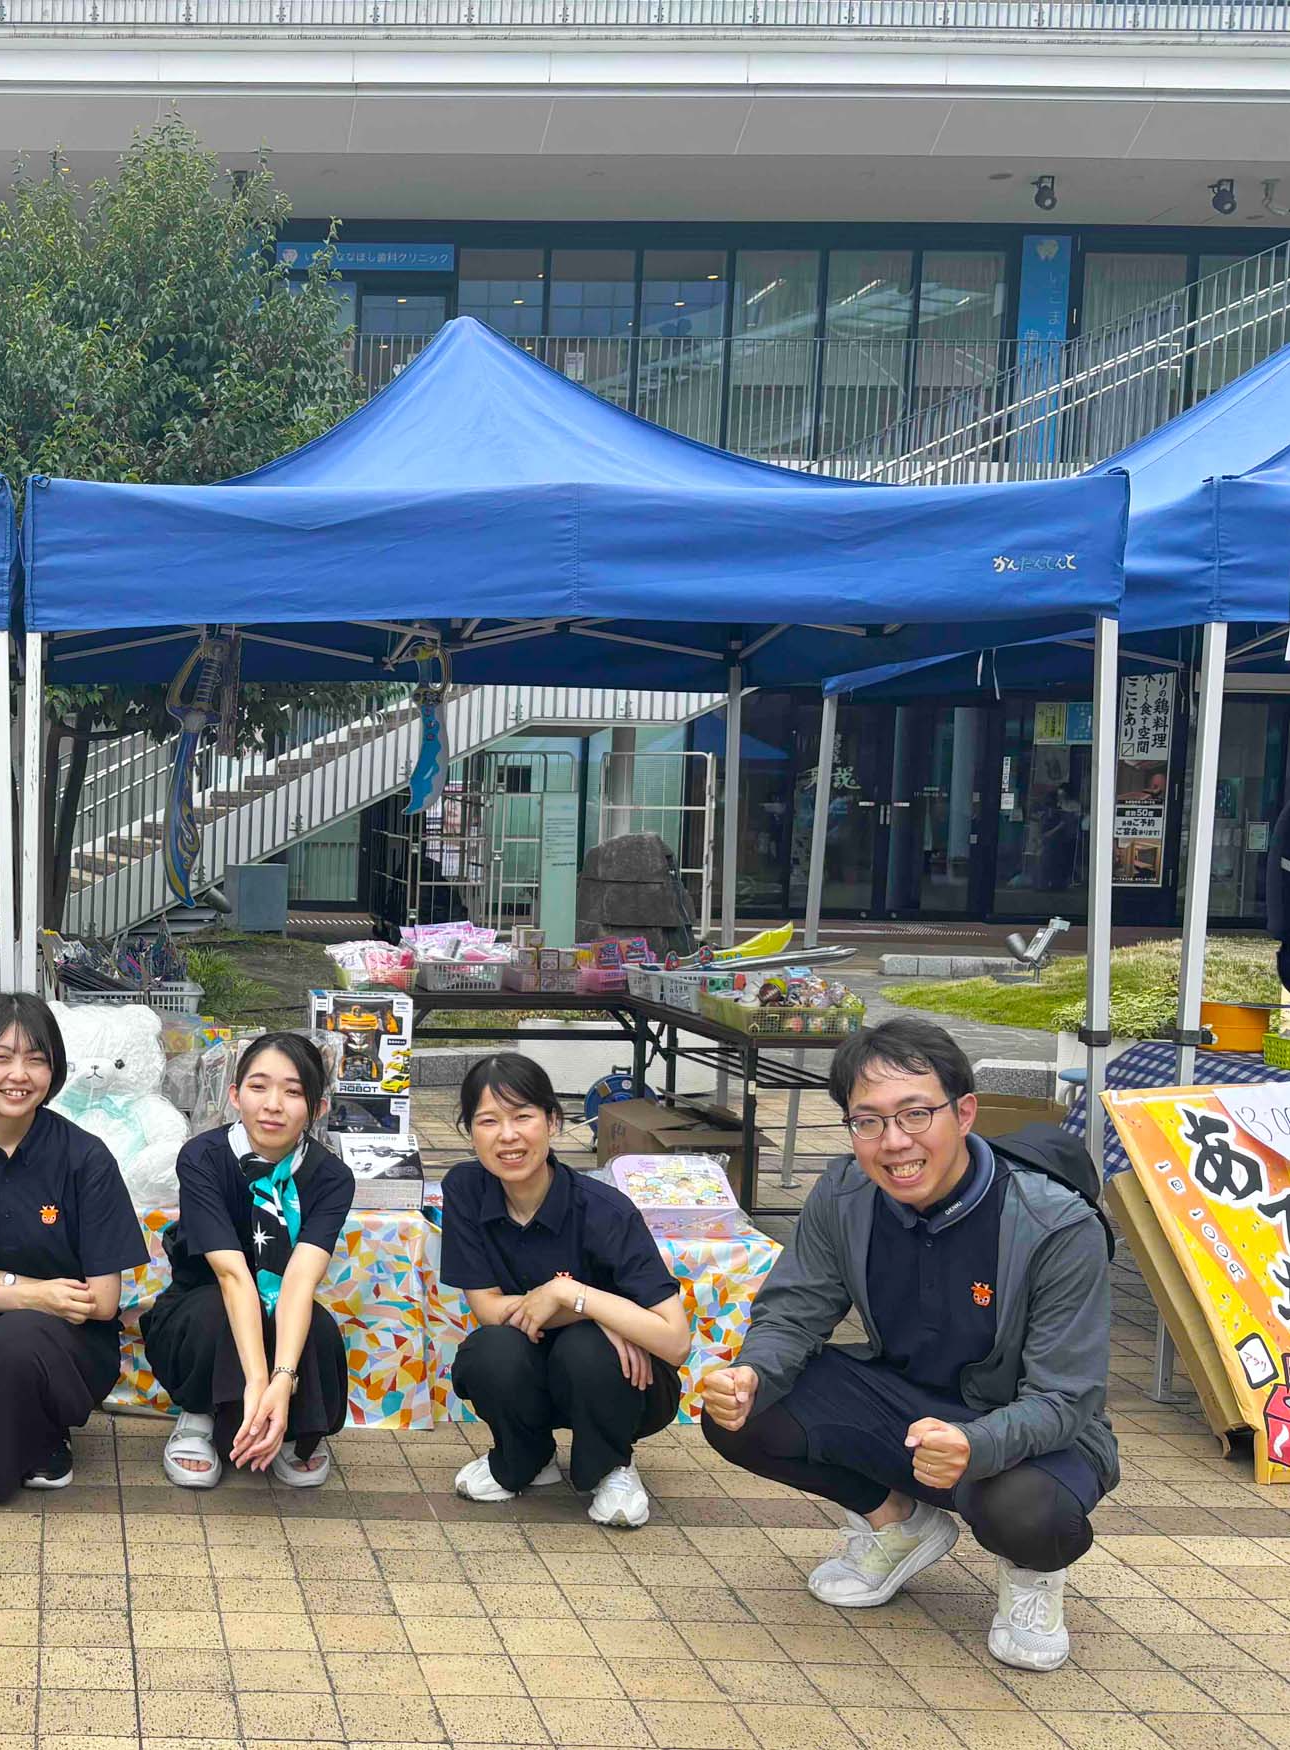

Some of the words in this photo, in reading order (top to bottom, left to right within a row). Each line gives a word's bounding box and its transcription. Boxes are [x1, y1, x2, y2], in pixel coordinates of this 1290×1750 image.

[1151, 676, 1170, 748] りの鶏料理
[1234, 1106, 1290, 1142] 13:0
